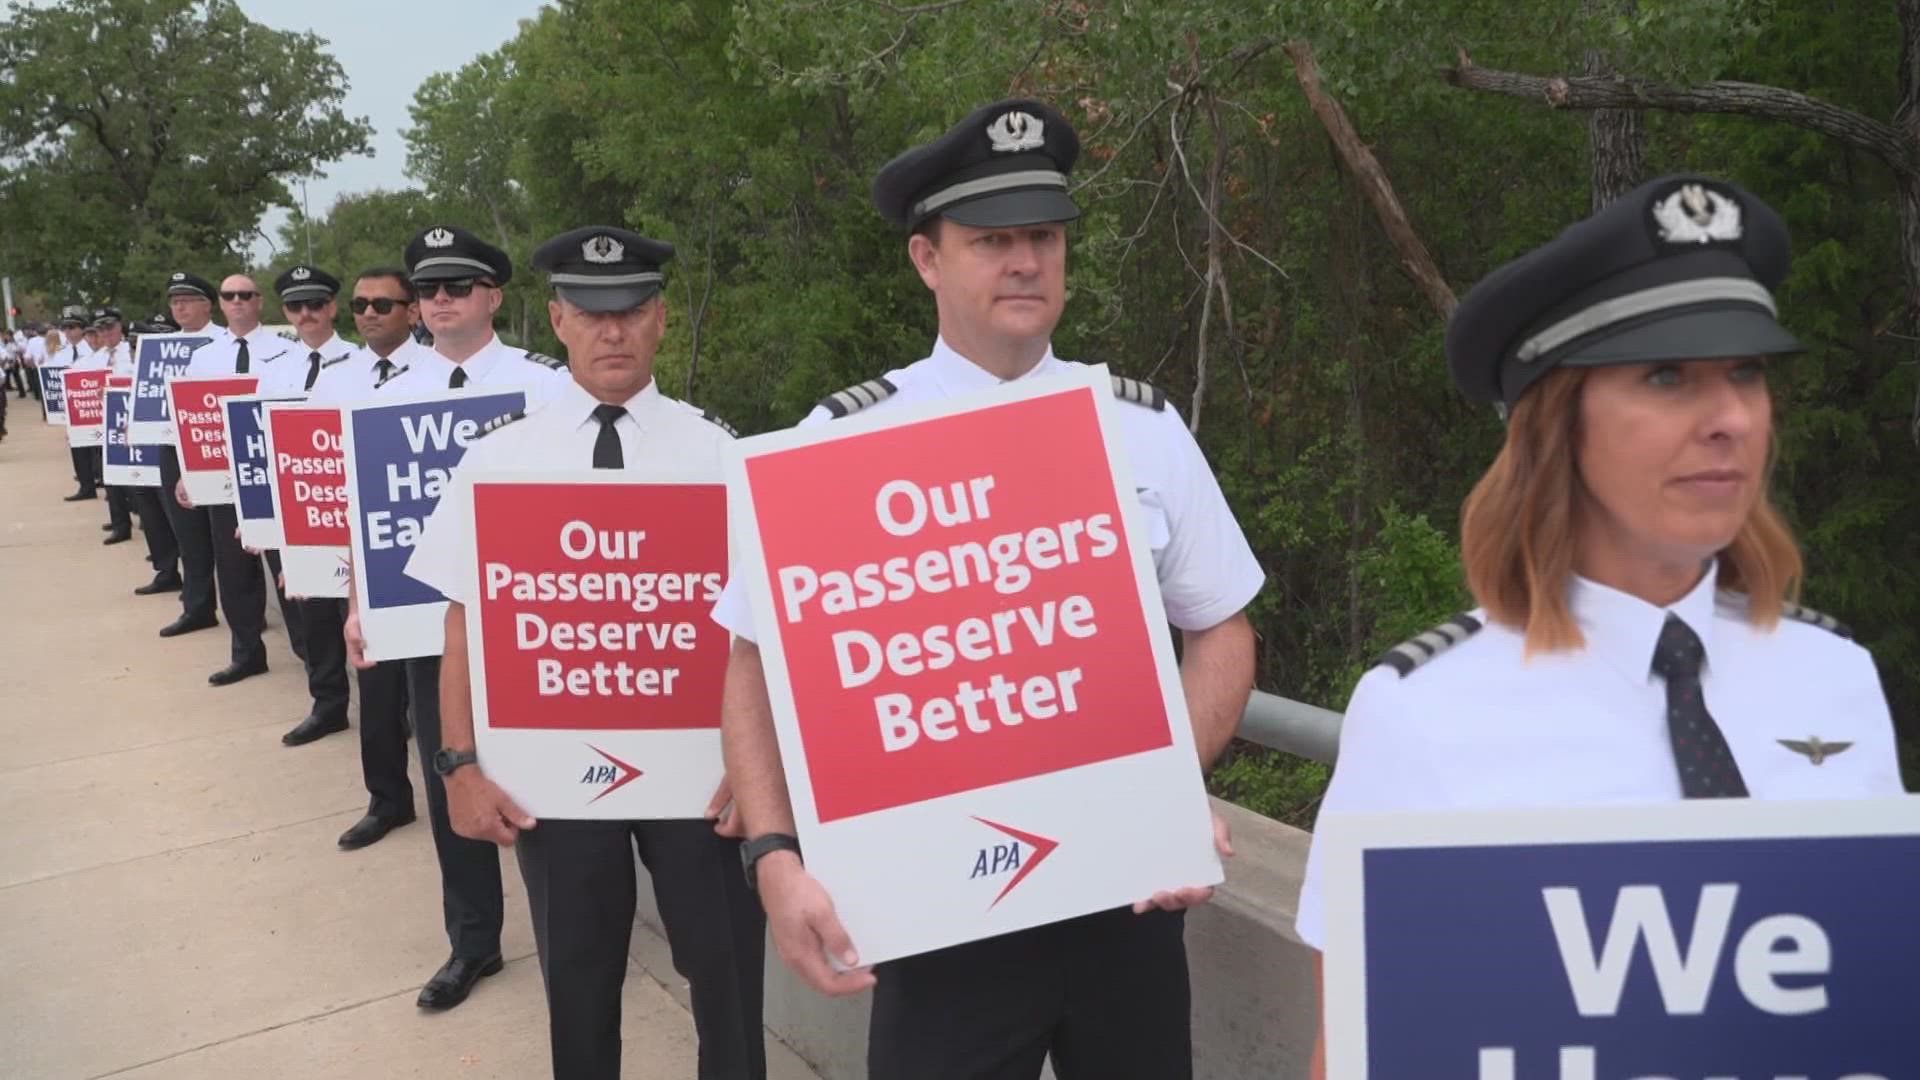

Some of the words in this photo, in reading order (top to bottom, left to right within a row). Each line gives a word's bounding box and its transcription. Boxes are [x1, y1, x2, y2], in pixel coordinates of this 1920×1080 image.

[160, 341, 190, 359] We
[67, 388, 98, 398] Passen
[80, 378, 98, 388] Our
[137, 380, 166, 398] Ear
[177, 409, 222, 425] Passe
[400, 411, 479, 454] We
[129, 446, 143, 462] It
[312, 429, 343, 452] Ou
[278, 452, 345, 475] Passen
[387, 461, 456, 502] Ha
[294, 480, 348, 502] Dese
[875, 474, 995, 537] Our
[559, 520, 646, 560] Our
[778, 513, 1119, 623] Passengers
[485, 563, 723, 612] Passengers
[516, 613, 697, 651] Deserve
[831, 595, 1097, 689] Deserve
[537, 659, 680, 697] Better
[874, 667, 1083, 753] Better
[581, 766, 617, 784] APA
[969, 842, 1021, 880] APA
[1541, 882, 1832, 1018] We
